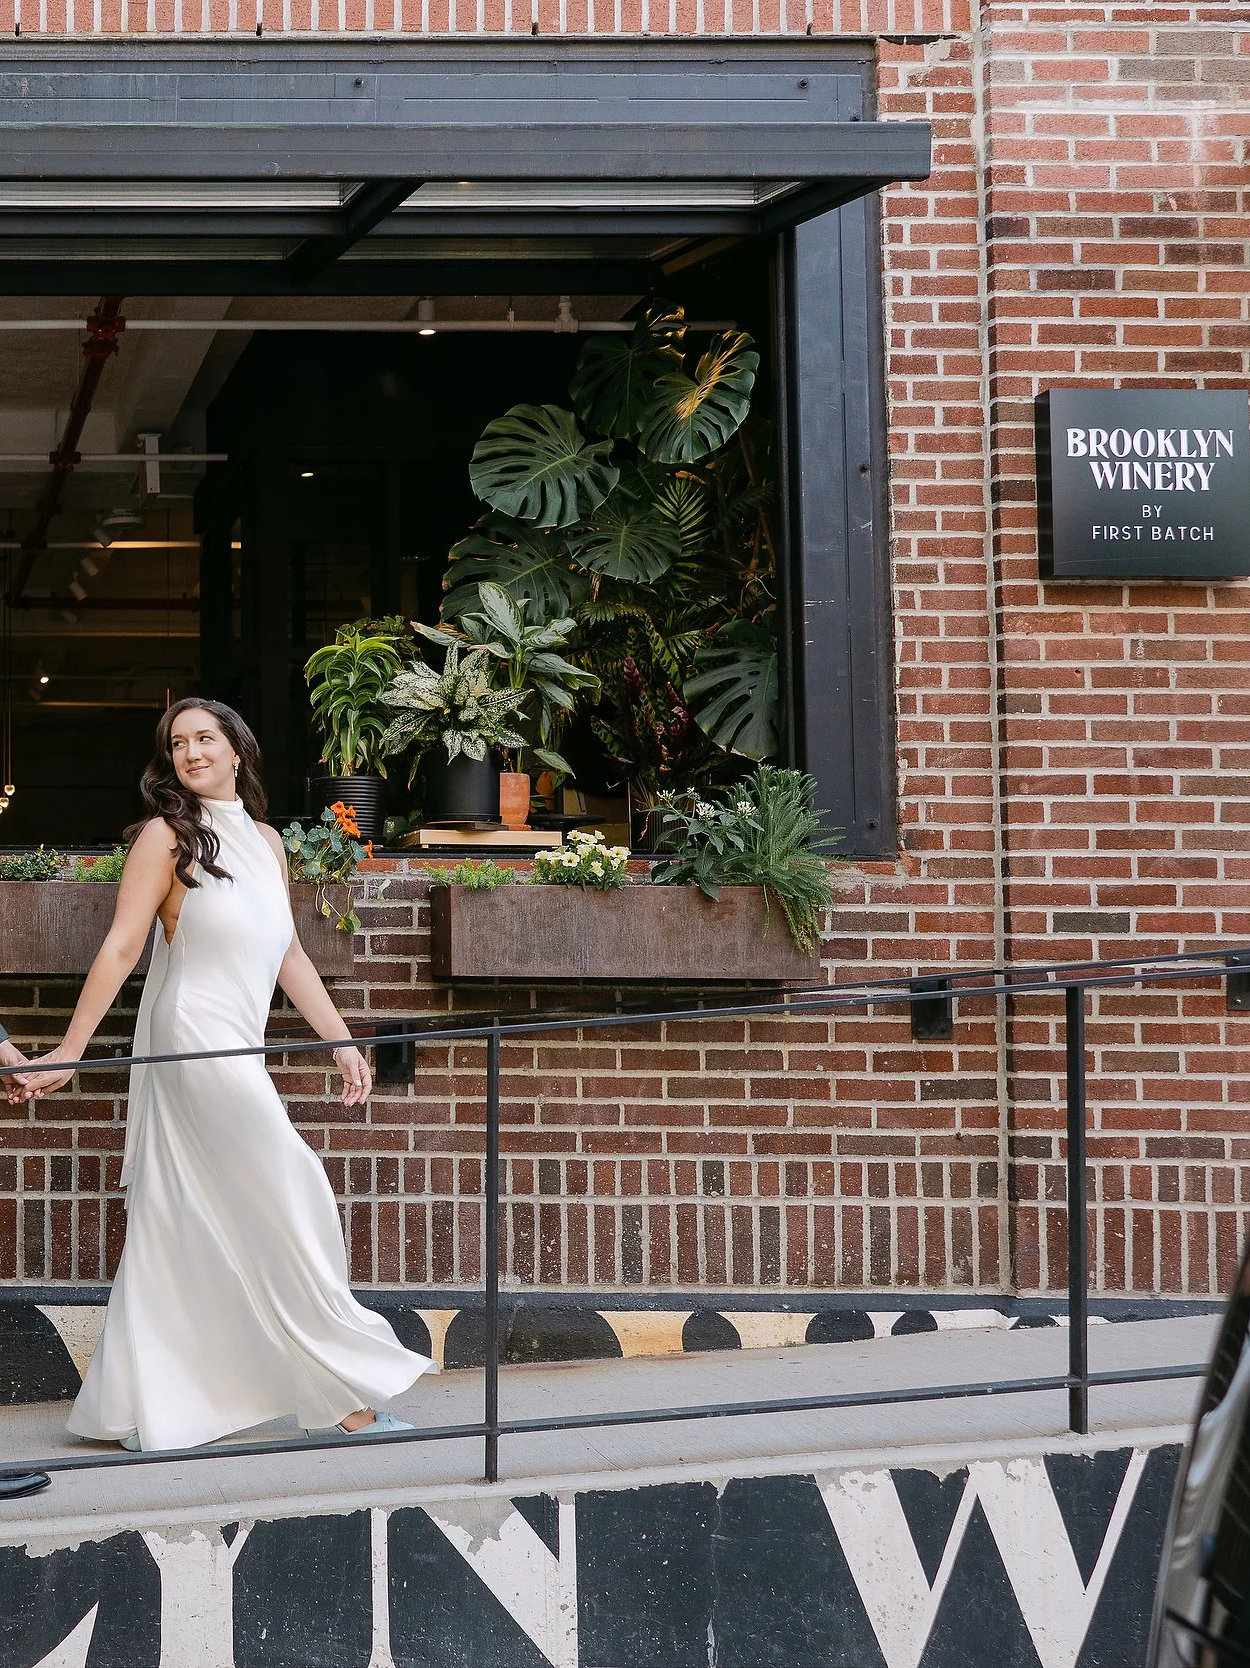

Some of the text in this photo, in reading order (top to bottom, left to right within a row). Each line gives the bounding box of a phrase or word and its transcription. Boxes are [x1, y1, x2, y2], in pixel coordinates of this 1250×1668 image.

[1066, 427, 1235, 460] BROOKLYN
[1088, 461, 1216, 493] WINERY
[1141, 504, 1163, 519] BY
[1092, 525, 1215, 542] FIRST BATCH
